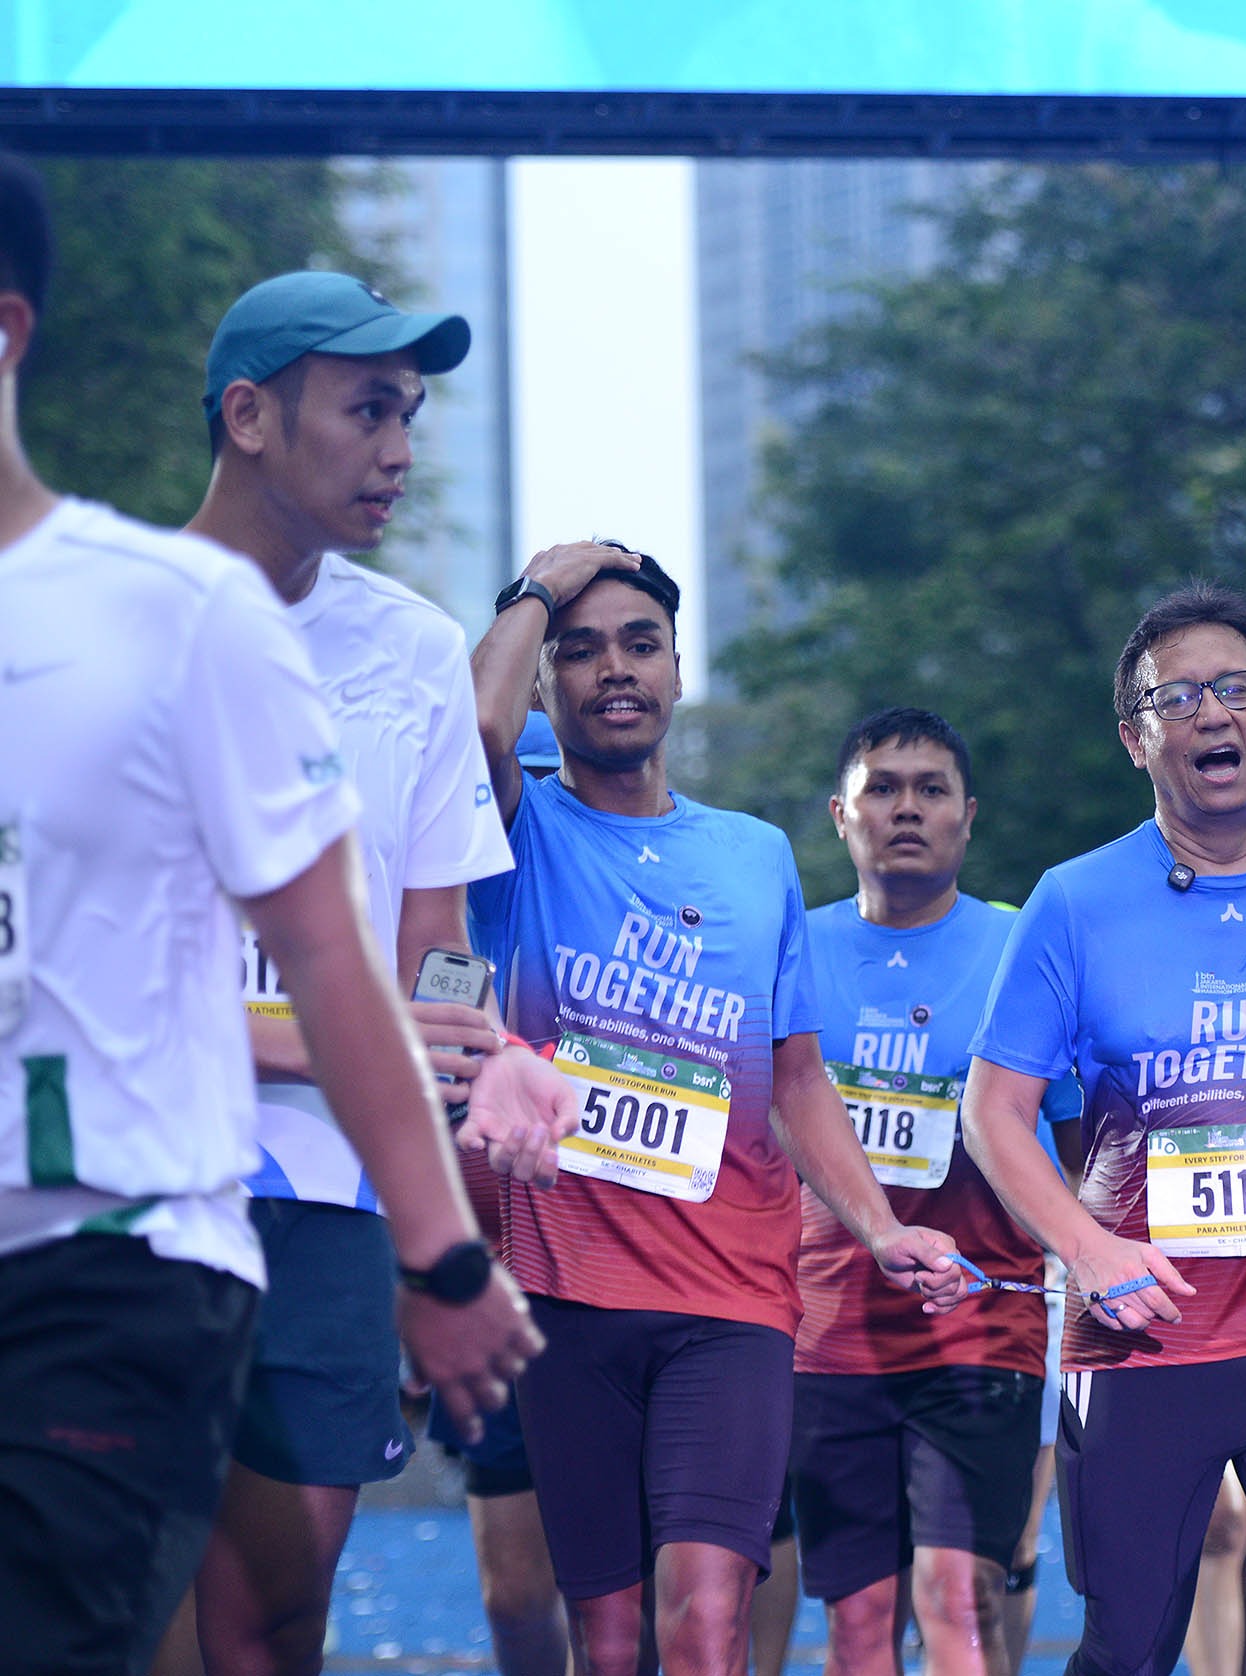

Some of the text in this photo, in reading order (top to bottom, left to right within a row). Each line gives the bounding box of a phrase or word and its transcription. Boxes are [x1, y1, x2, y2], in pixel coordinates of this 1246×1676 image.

[613, 911, 702, 977] RUN
[555, 944, 745, 1042] TOGETHER
[599, 1018, 649, 1042] abilities,
[651, 1032, 675, 1047] one
[677, 1036, 707, 1058] finish
[708, 1045, 729, 1063] line
[852, 1032, 929, 1074] RUN
[609, 1075, 677, 1097] UNSTOPABLE RUN
[692, 1071, 713, 1088] bsn
[1190, 1089, 1245, 1103] abilities,
[581, 1086, 689, 1155] 5001
[595, 1146, 657, 1167] PARA ATHLETES
[1184, 1156, 1208, 1165] EVERY
[1209, 1155, 1228, 1163] STEP
[1229, 1154, 1245, 1162] FOR
[1196, 1226, 1218, 1235] PARA
